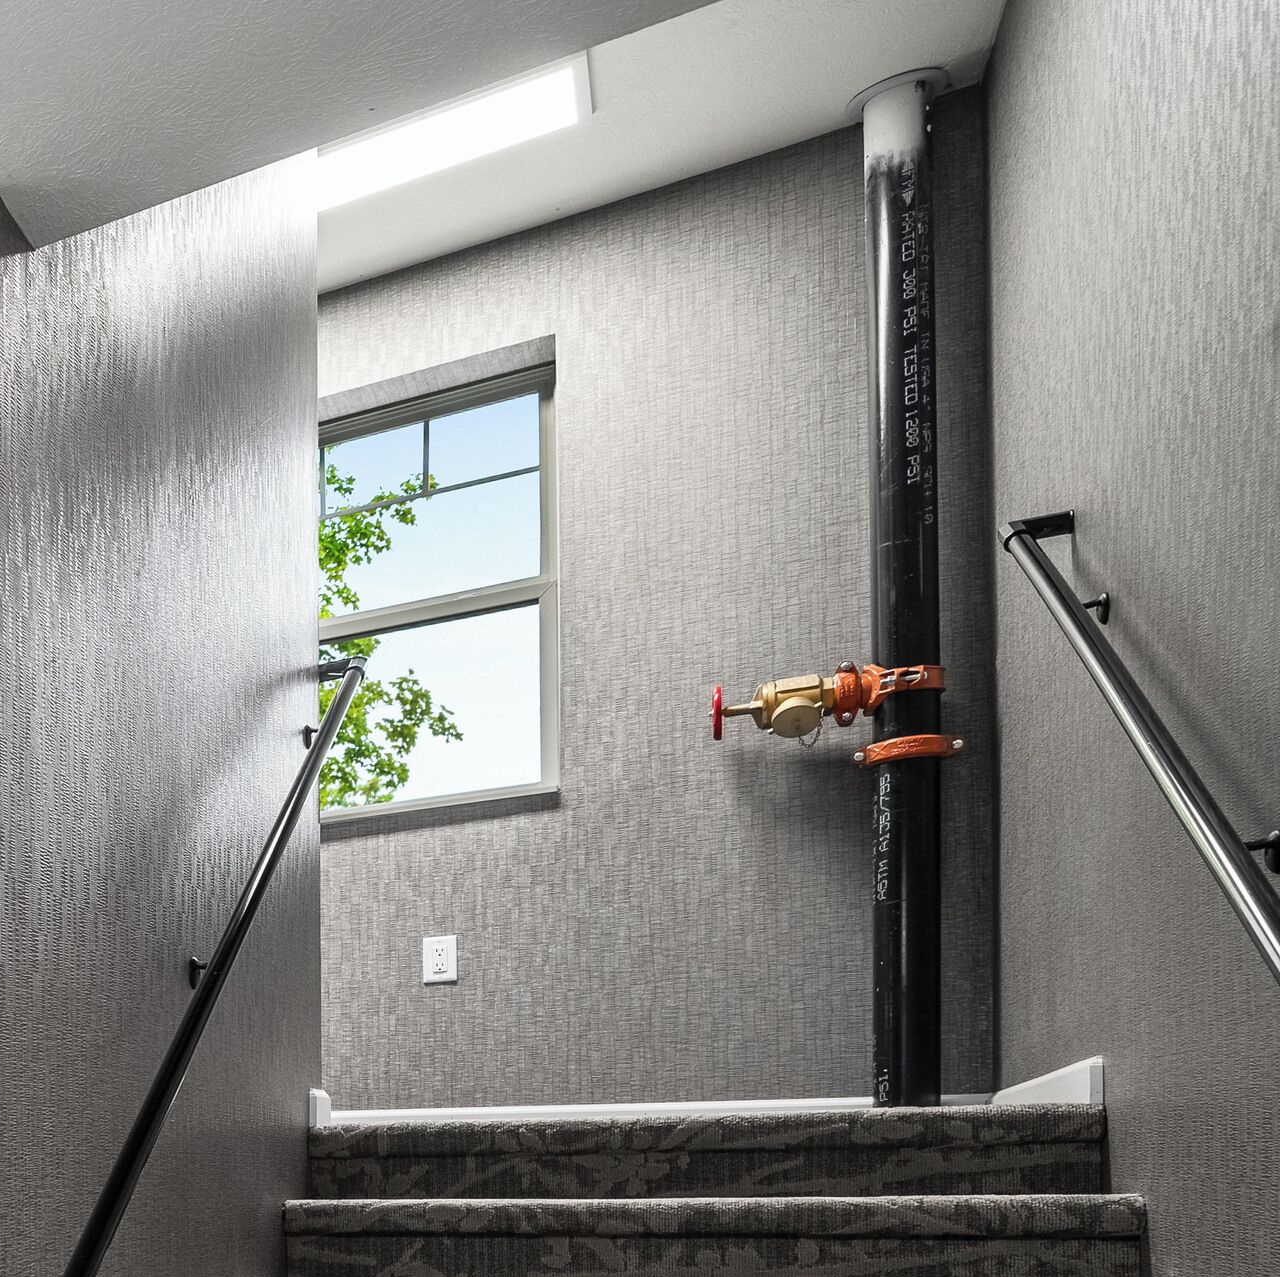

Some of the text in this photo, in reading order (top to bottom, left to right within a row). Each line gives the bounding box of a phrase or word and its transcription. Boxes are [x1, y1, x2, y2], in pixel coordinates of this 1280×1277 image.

[901, 210, 916, 262] RATED
[903, 267, 917, 300] 300
[903, 305, 918, 337] PSI
[904, 344, 919, 406] TESTED
[905, 408, 920, 448] 1200
[907, 454, 921, 485] PSI
[877, 859, 889, 901] ASTM
